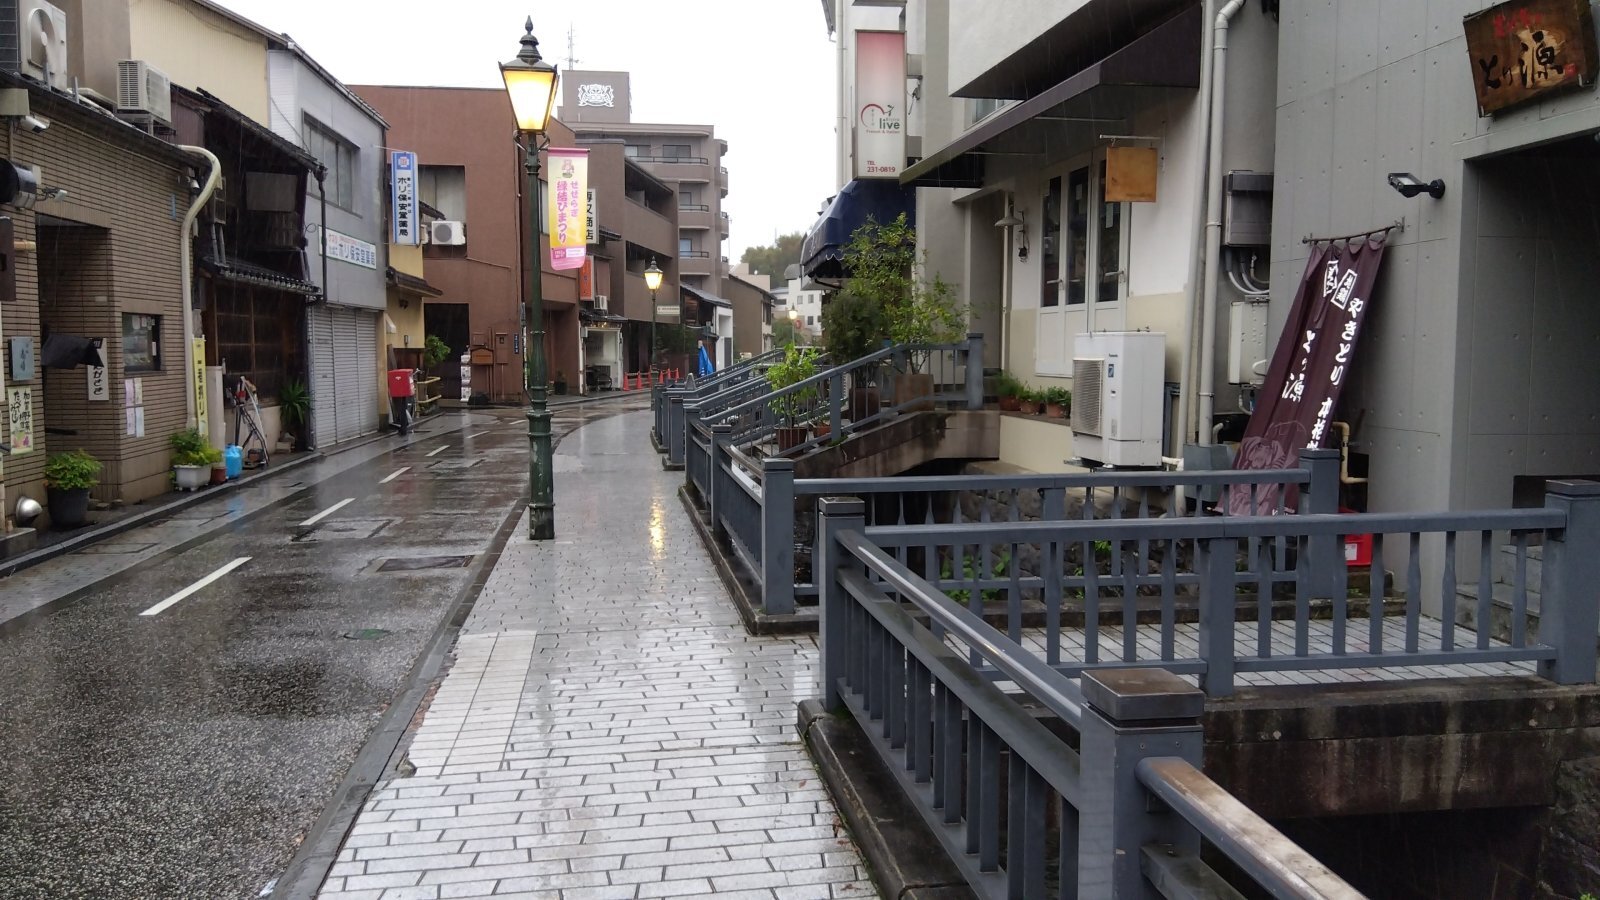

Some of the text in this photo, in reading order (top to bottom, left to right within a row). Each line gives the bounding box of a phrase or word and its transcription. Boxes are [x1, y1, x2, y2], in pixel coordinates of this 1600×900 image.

[398, 177, 409, 236] ホリ保安堂薬局
[556, 180, 568, 243] 縁結びまつり
[570, 181, 578, 217] せせらぎ
[1330, 298, 1363, 386] やきとり
